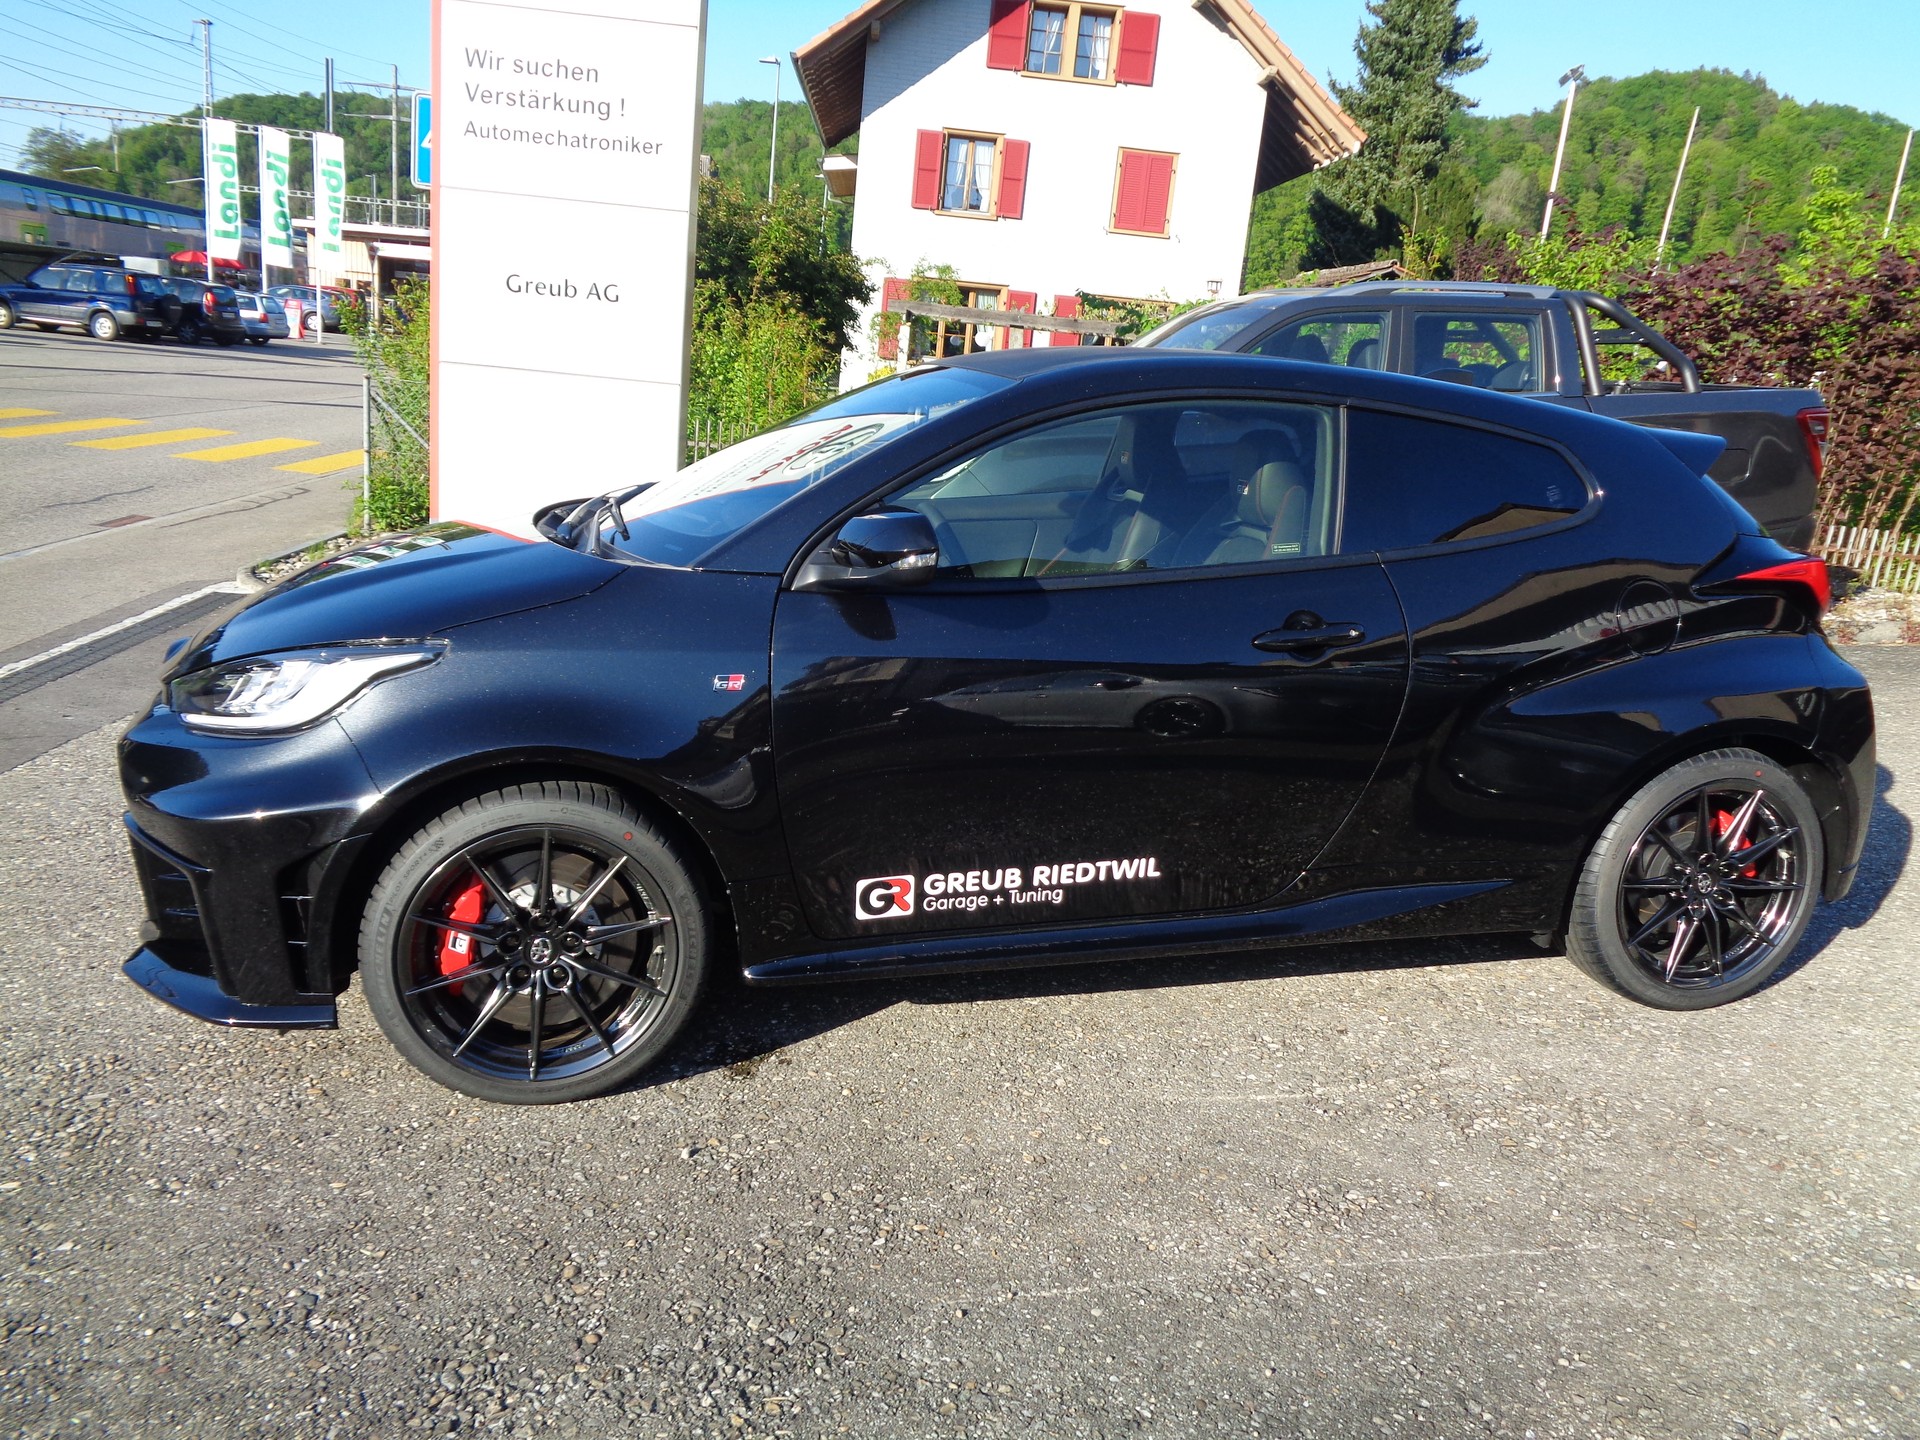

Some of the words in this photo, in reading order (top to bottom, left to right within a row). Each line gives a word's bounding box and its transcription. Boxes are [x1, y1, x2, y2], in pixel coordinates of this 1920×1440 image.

[463, 47, 505, 71] Wir
[513, 57, 599, 83] suchen
[464, 82, 611, 121] Verstärkung
[620, 97, 626, 117] !
[463, 120, 663, 155] Automechatroniker
[212, 143, 241, 241] Landi
[266, 150, 293, 249] Landi
[505, 273, 578, 299] Greub
[586, 282, 619, 303] AG
[923, 867, 1023, 896] GREUB
[1032, 857, 1161, 887] RIEDTWIL
[857, 877, 912, 917] GR
[923, 893, 989, 912] Garage
[993, 893, 1005, 905] +
[1009, 888, 1065, 904] Tuning
